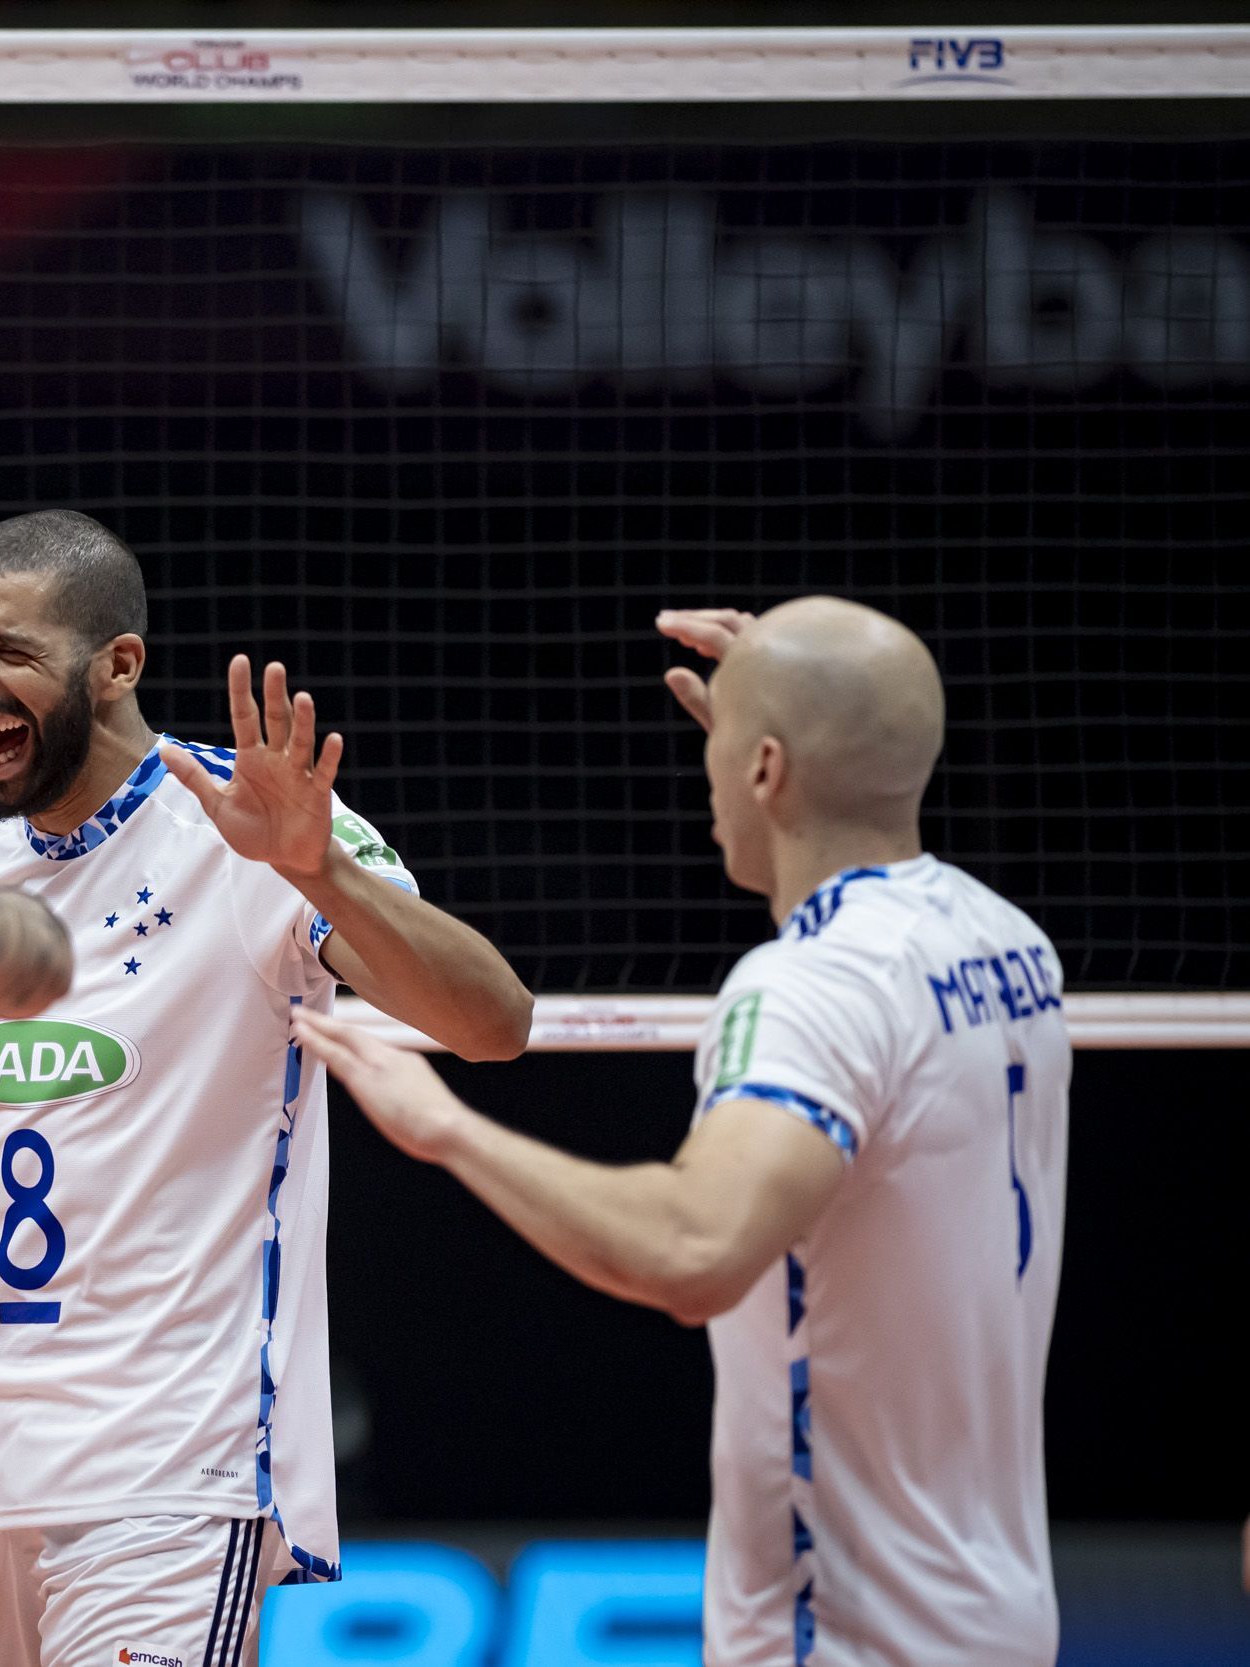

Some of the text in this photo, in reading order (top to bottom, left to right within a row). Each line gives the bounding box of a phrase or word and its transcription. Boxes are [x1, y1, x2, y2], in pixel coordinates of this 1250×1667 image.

[910, 38, 1004, 69] FIVB
[295, 186, 1250, 442] Volleyba
[200, 1467, 239, 1478] AEROREADY
[129, 1651, 183, 1667] emcash
